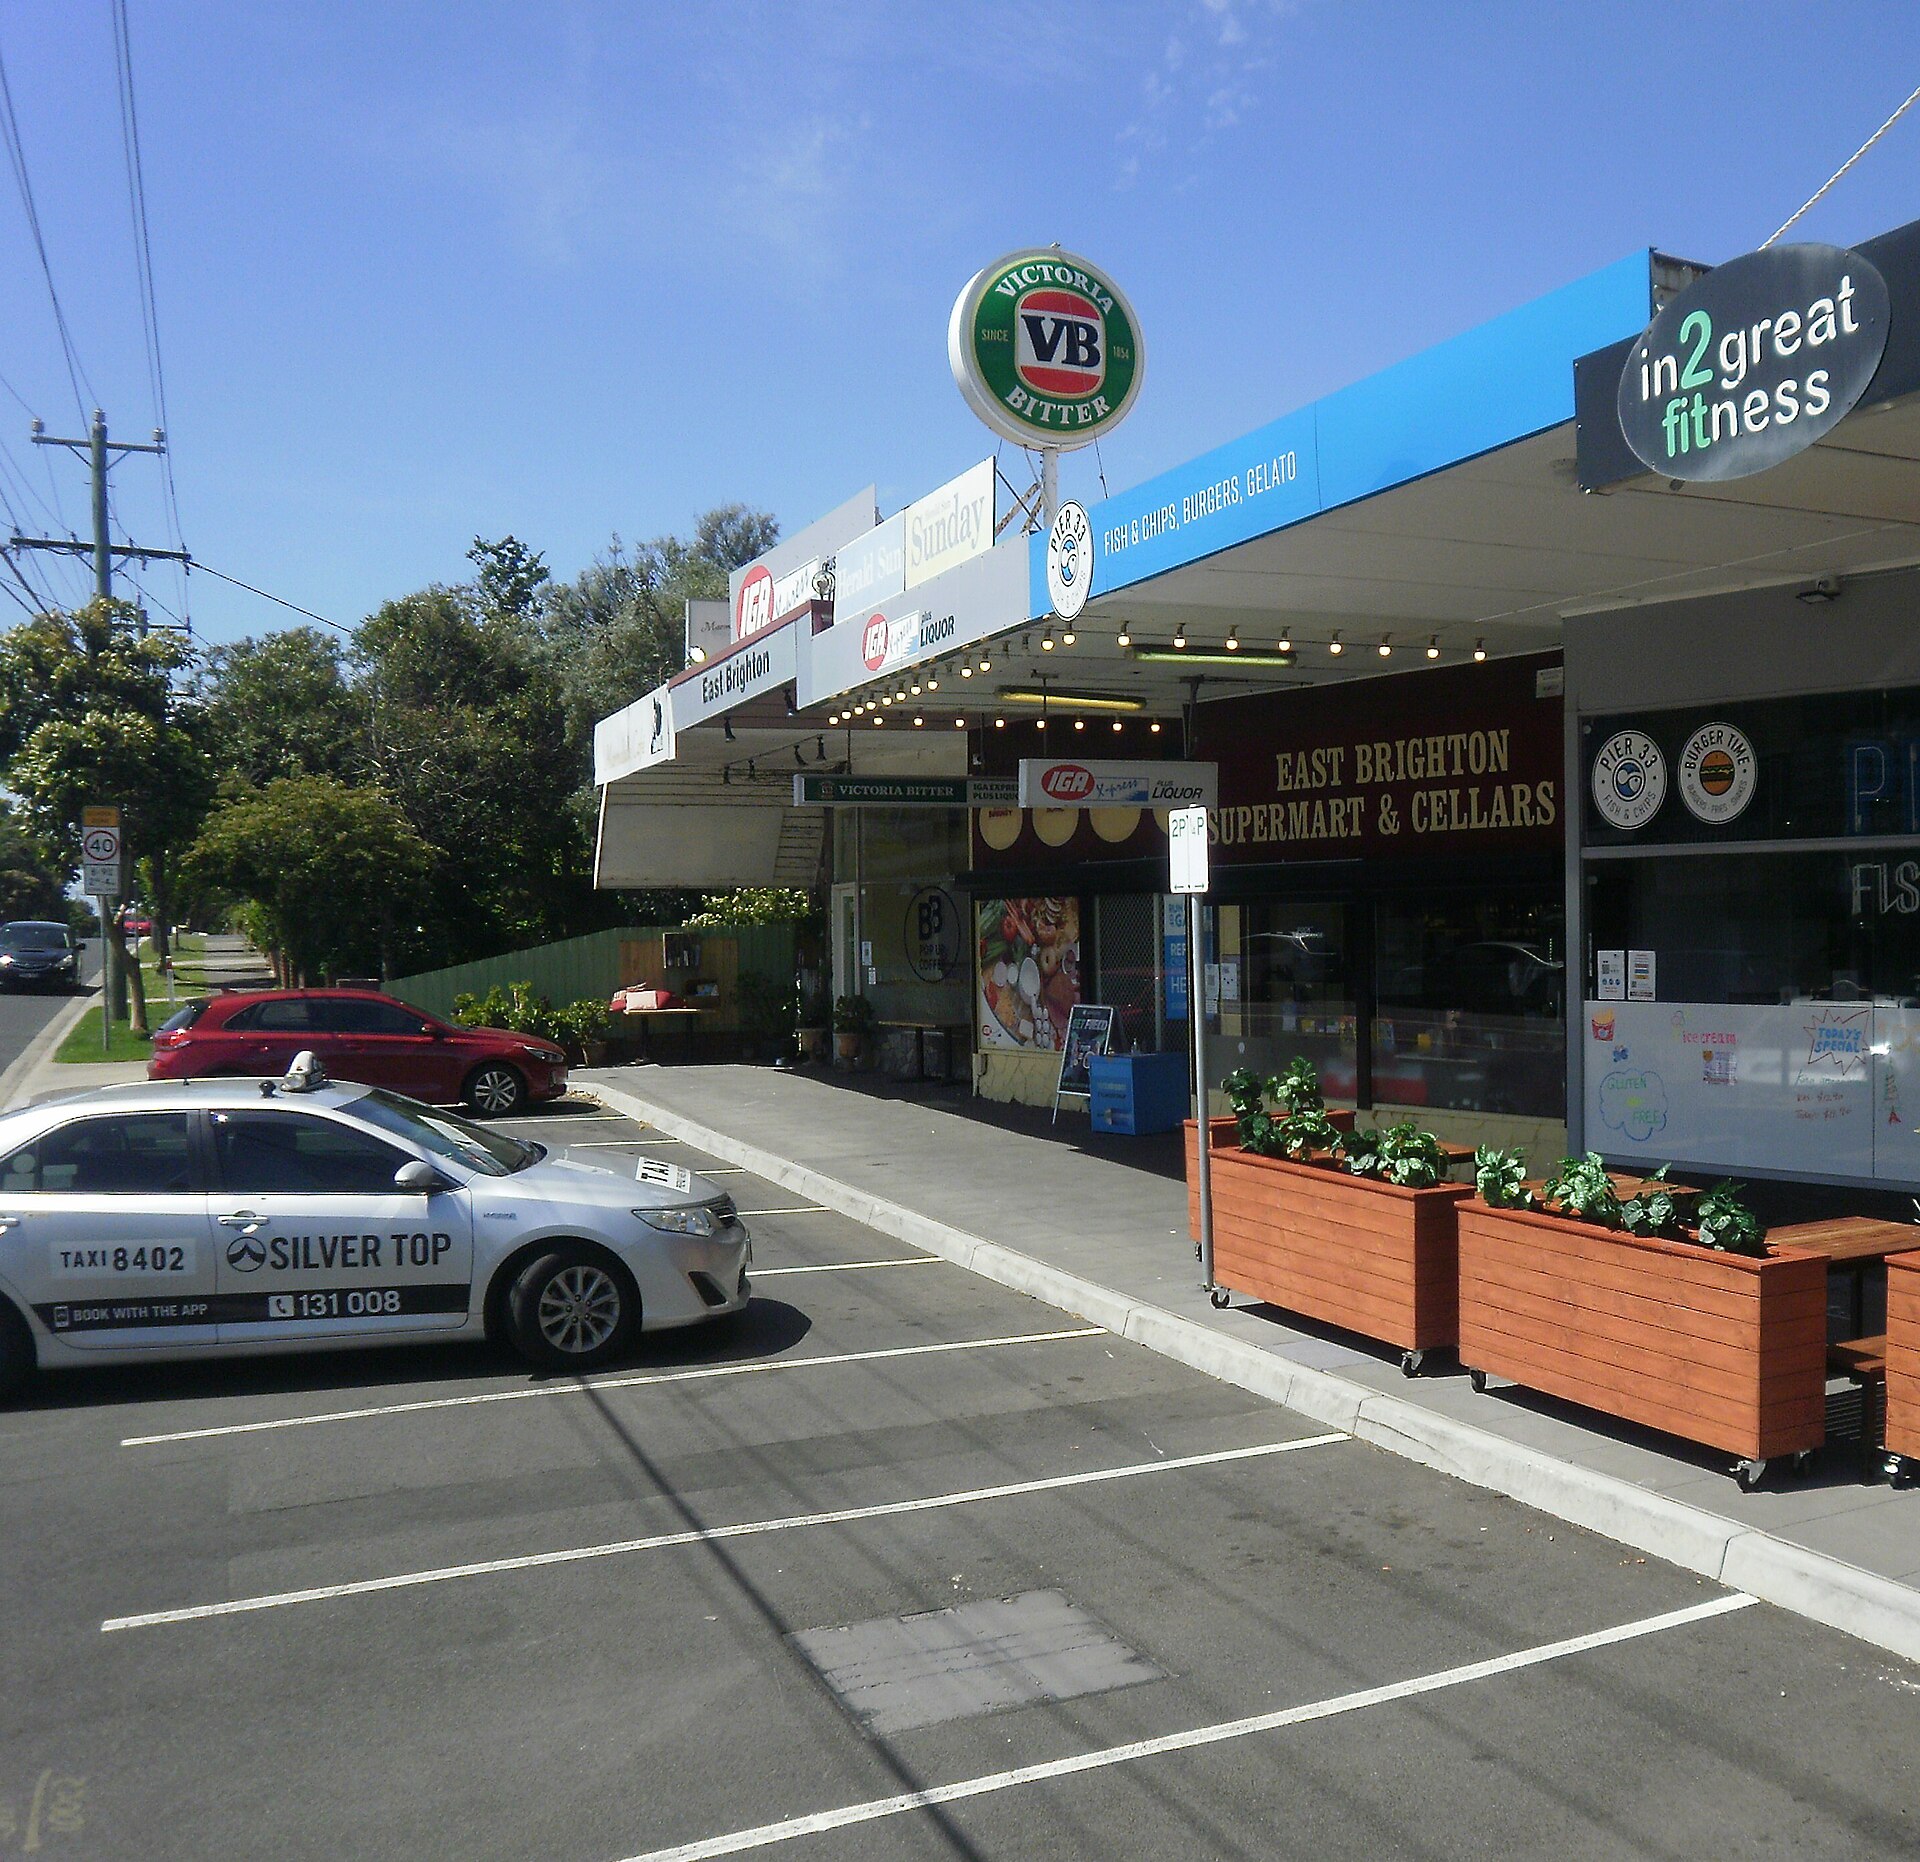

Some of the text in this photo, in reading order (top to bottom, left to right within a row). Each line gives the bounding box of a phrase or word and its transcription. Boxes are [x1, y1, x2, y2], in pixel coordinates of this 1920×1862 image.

[995, 264, 1115, 315] VICTORIA
[981, 328, 1009, 343] SINCE
[1020, 314, 1101, 369] VB
[1005, 384, 1111, 425] BITTER
[1662, 369, 1831, 458] fitness
[1104, 450, 1297, 556] FISH & CHIPS, BURGERS, GELATO
[911, 492, 985, 567] Sunday
[1051, 509, 1086, 553] PIER 33
[838, 546, 901, 599] Herald Sun
[740, 575, 771, 639] IGA
[864, 621, 887, 662] IGA
[920, 615, 955, 647] LIQUOR
[702, 648, 770, 703] East Brighton
[1276, 729, 1510, 792] EAST BRIGHTON
[1600, 738, 1658, 771] PIER 33
[1685, 729, 1750, 770] BURGER TIME
[839, 784, 954, 798] VICTORIA BITTER
[1048, 771, 1090, 793] IGA
[1152, 787, 1203, 799] LIQUOR
[1209, 781, 1556, 845] SUPERMART & CELLARS
[1603, 794, 1621, 816] FISH
[1633, 791, 1657, 818] CHIPS
[1172, 818, 1187, 837] 2P
[90, 839, 113, 853] 40
[1683, 1030, 1737, 1045] ice cream
[1814, 1041, 1860, 1053] SPECIAL
[1818, 1027, 1862, 1041] TODAY'S
[1607, 1076, 1647, 1090] GLUTEN
[1632, 1110, 1661, 1125] FREE
[60, 1246, 185, 1272] TAXI 8402
[270, 1233, 452, 1270] SILVER TOP
[73, 1303, 208, 1323] BOOK WITH THE APP
[299, 1290, 401, 1317] 131 008
